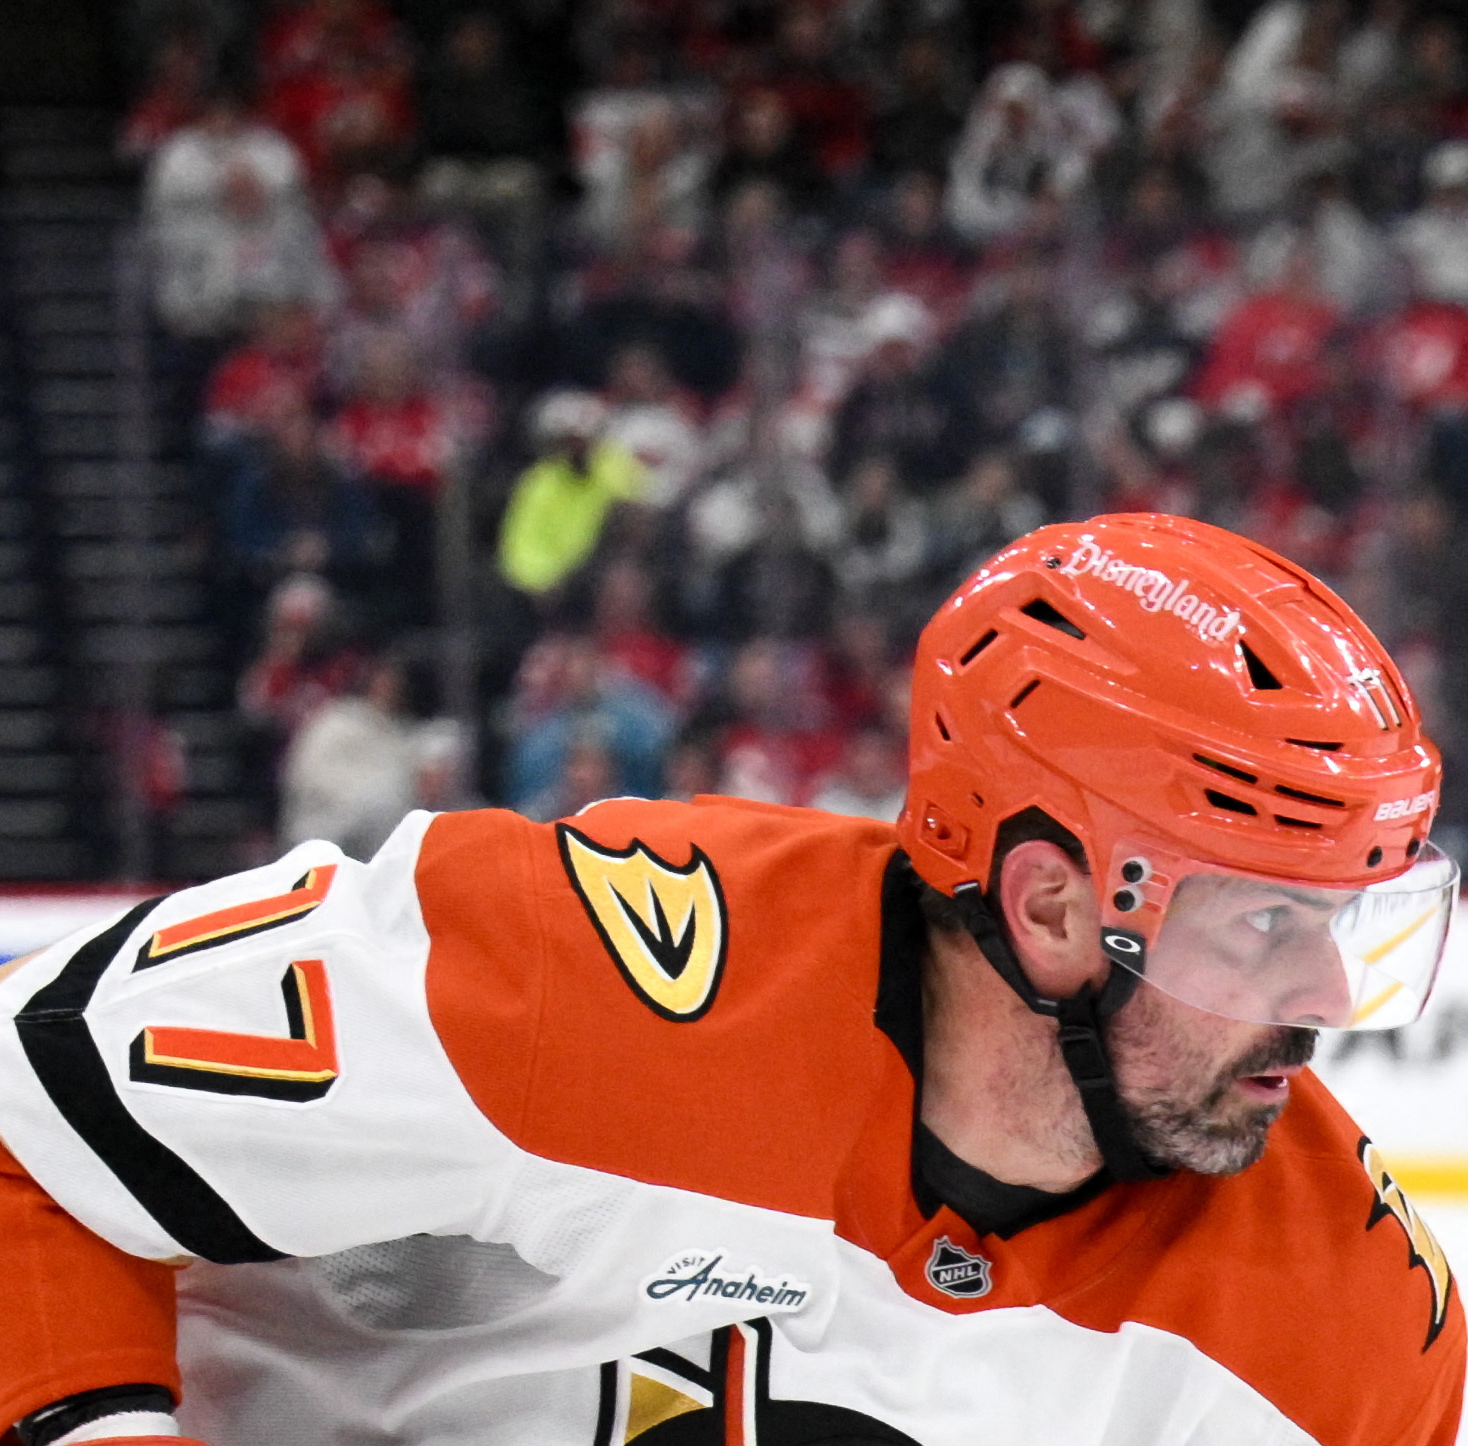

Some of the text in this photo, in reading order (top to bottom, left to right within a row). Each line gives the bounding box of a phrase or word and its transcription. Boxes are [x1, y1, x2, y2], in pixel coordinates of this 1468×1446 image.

[1063, 538, 1246, 648] Disneyland
[129, 863, 340, 1104] 17
[646, 1254, 807, 1307] Anaheim
[666, 1256, 706, 1275] VISIT
[938, 1264, 978, 1286] NHL
